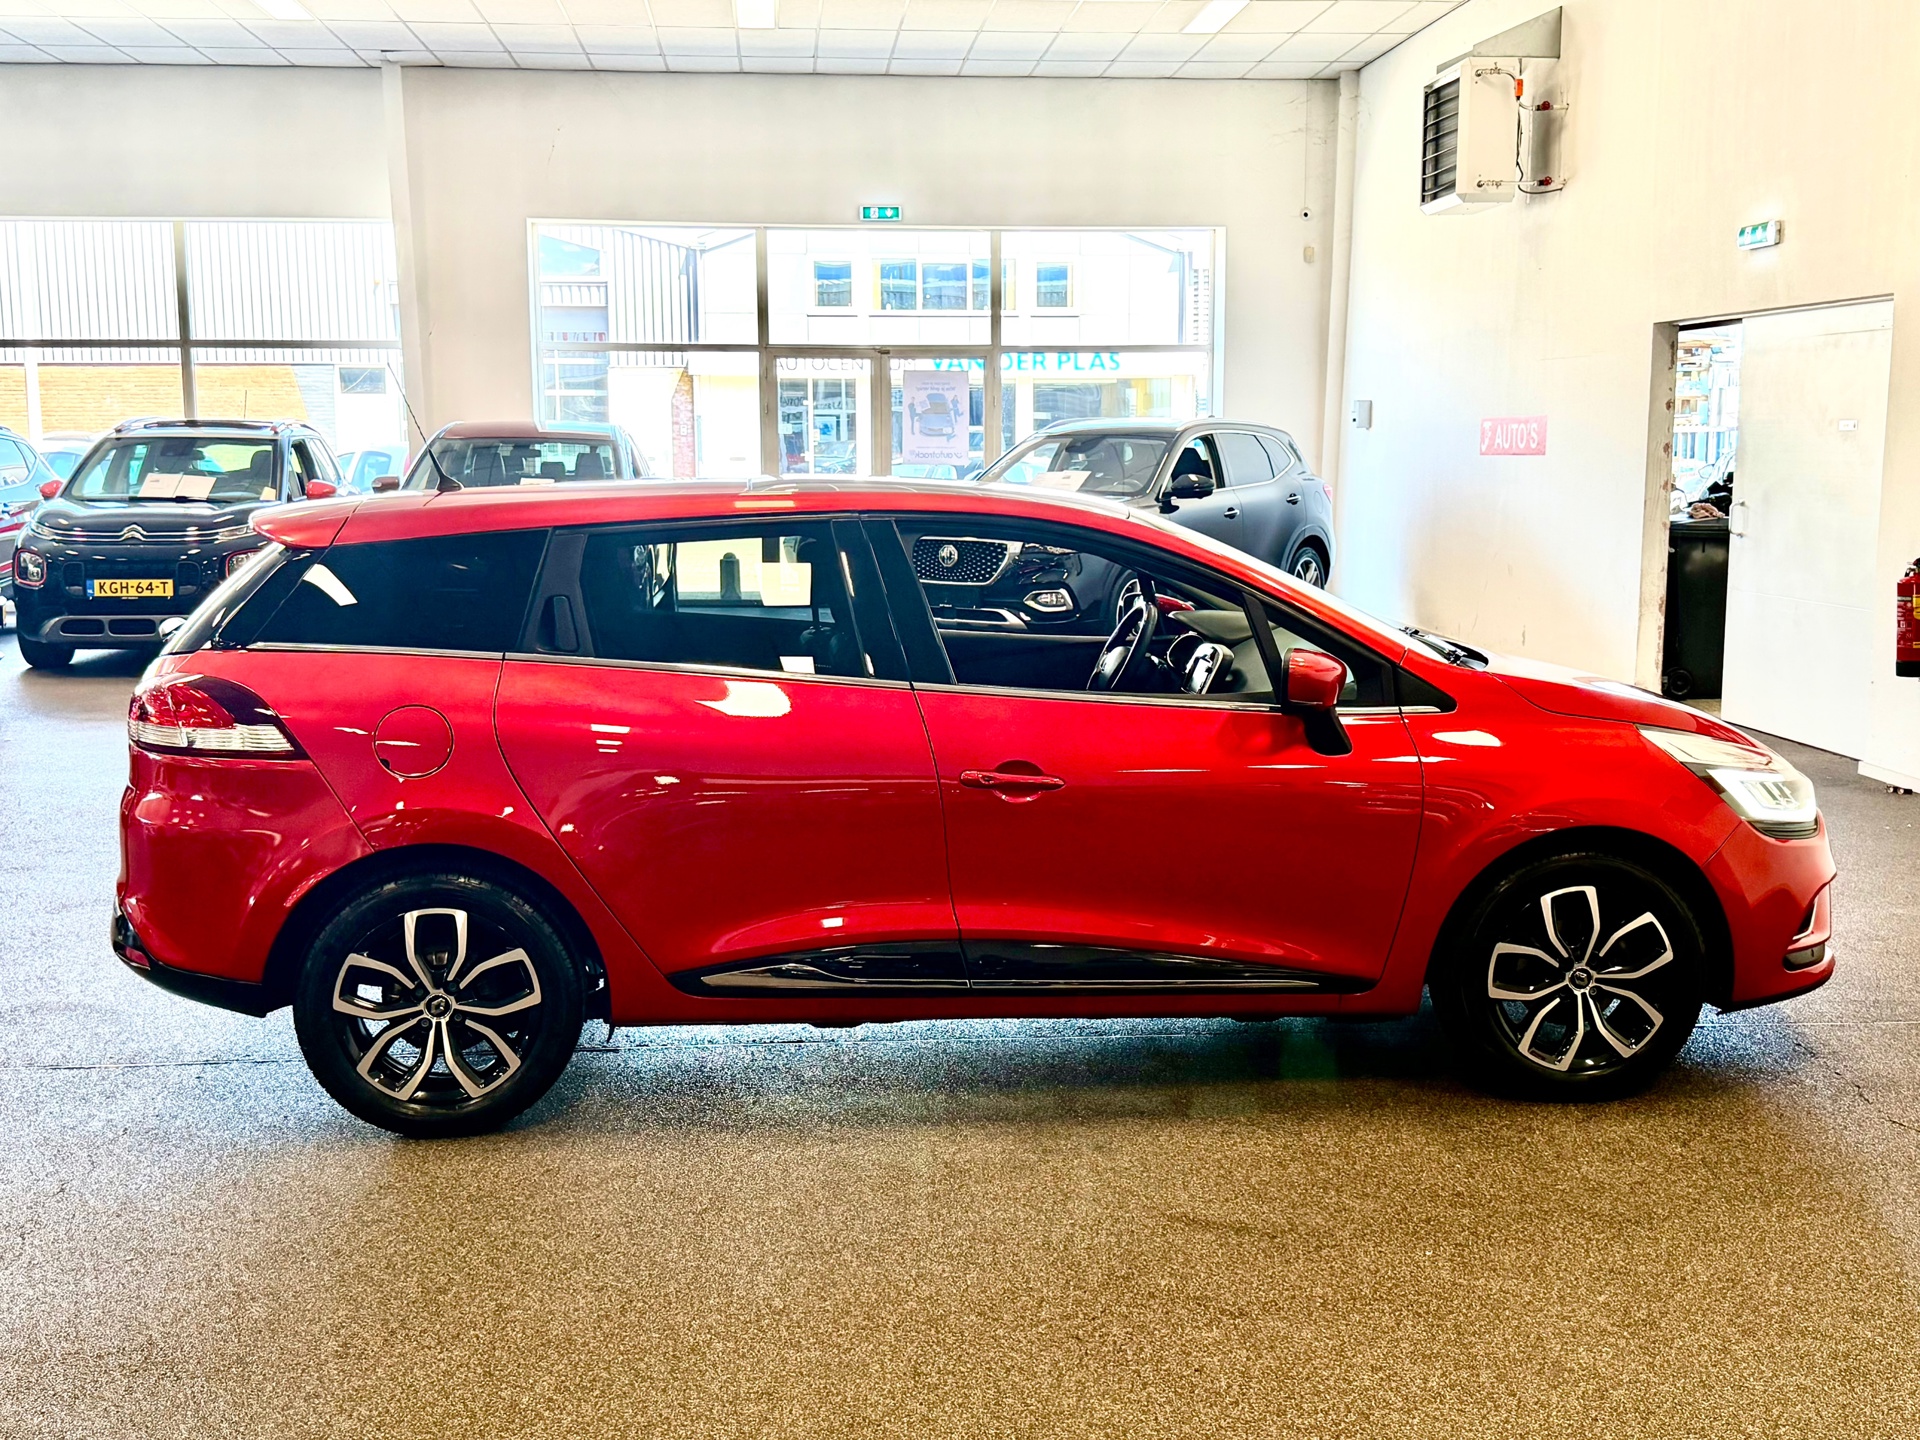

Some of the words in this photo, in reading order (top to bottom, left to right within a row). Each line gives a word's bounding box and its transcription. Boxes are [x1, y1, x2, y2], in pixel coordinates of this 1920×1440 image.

[932, 357, 985, 371] VAN
[1001, 351, 1047, 371] DER
[1057, 351, 1121, 371] PLAS
[1494, 422, 1539, 449] AUTO'S
[98, 581, 169, 595] KGH-64-T
